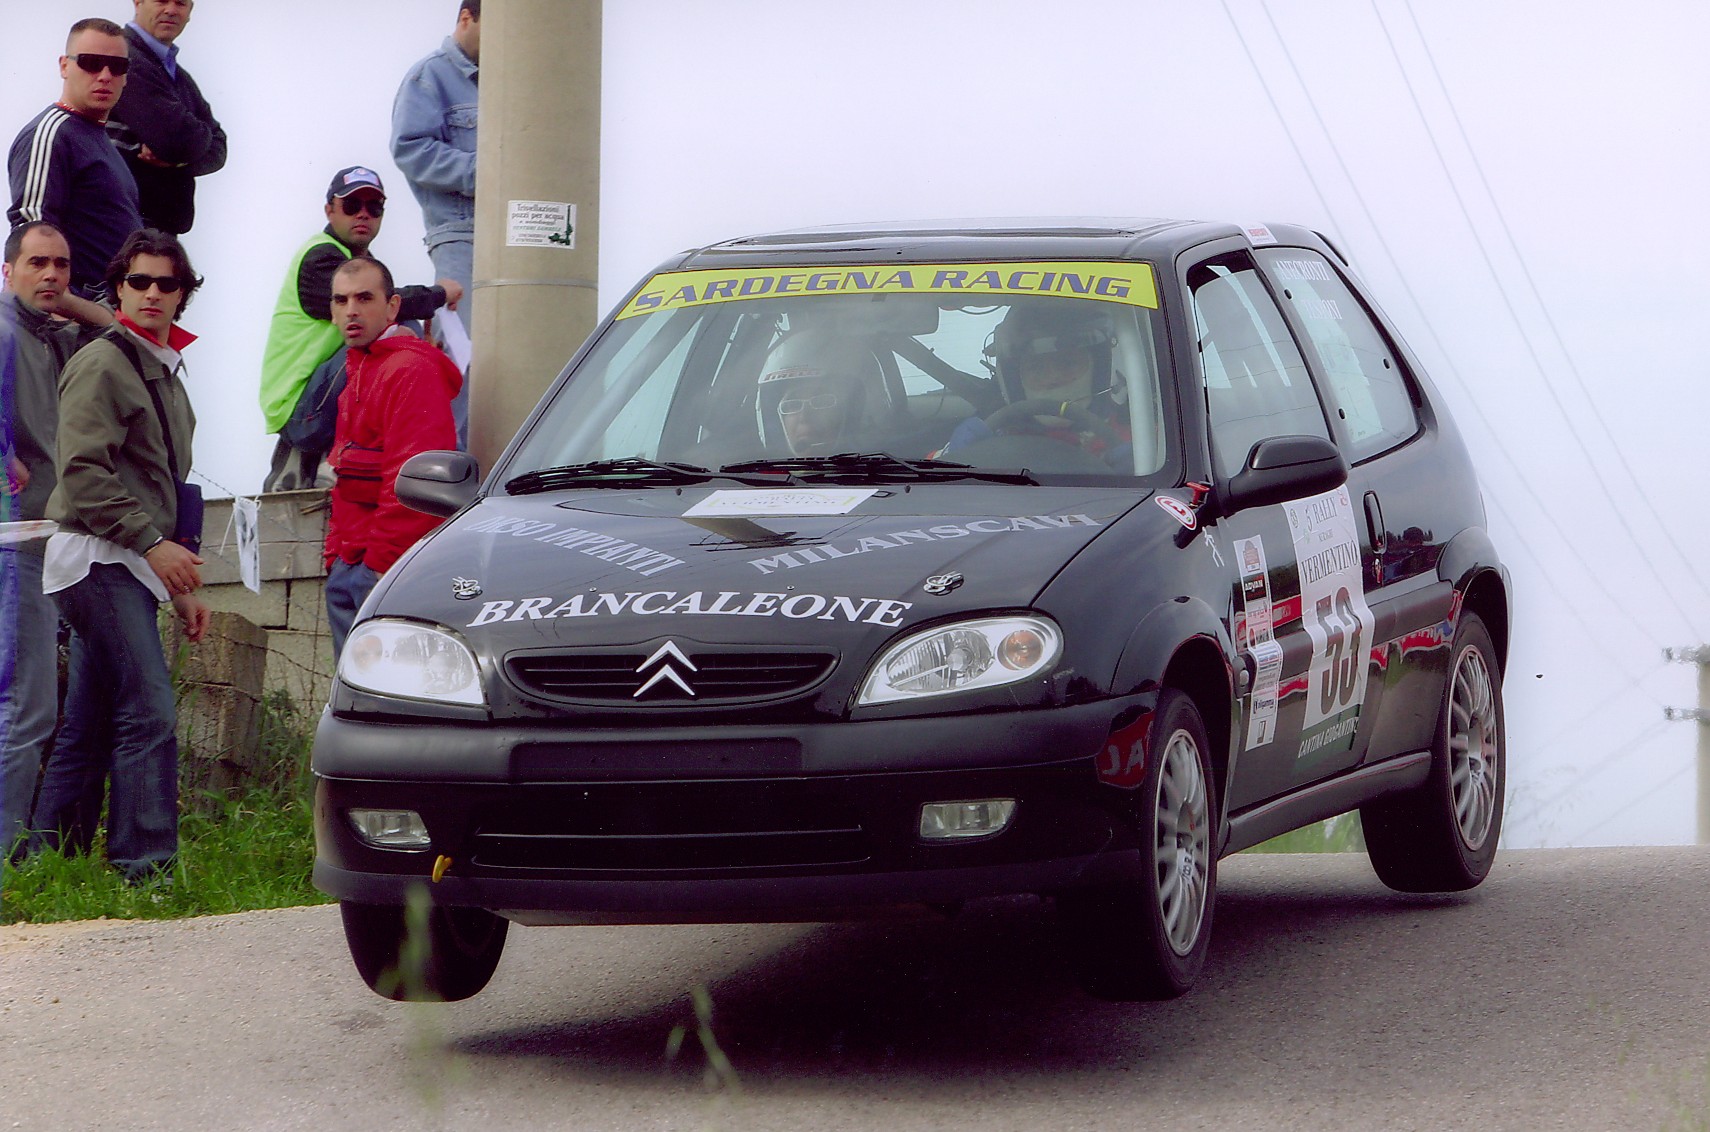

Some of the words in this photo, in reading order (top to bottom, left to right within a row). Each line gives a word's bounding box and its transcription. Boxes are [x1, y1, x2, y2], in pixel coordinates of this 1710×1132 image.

[544, 214, 565, 222] acqua
[632, 270, 903, 313] SARDEGNA
[930, 270, 1132, 298] RACING
[1312, 496, 1338, 524] RALLY
[534, 527, 686, 577] IMPIANTI
[747, 513, 1102, 575] MILANSCAVI
[1301, 539, 1359, 586] VERMENTINO
[466, 591, 913, 628] BRANCALEONE
